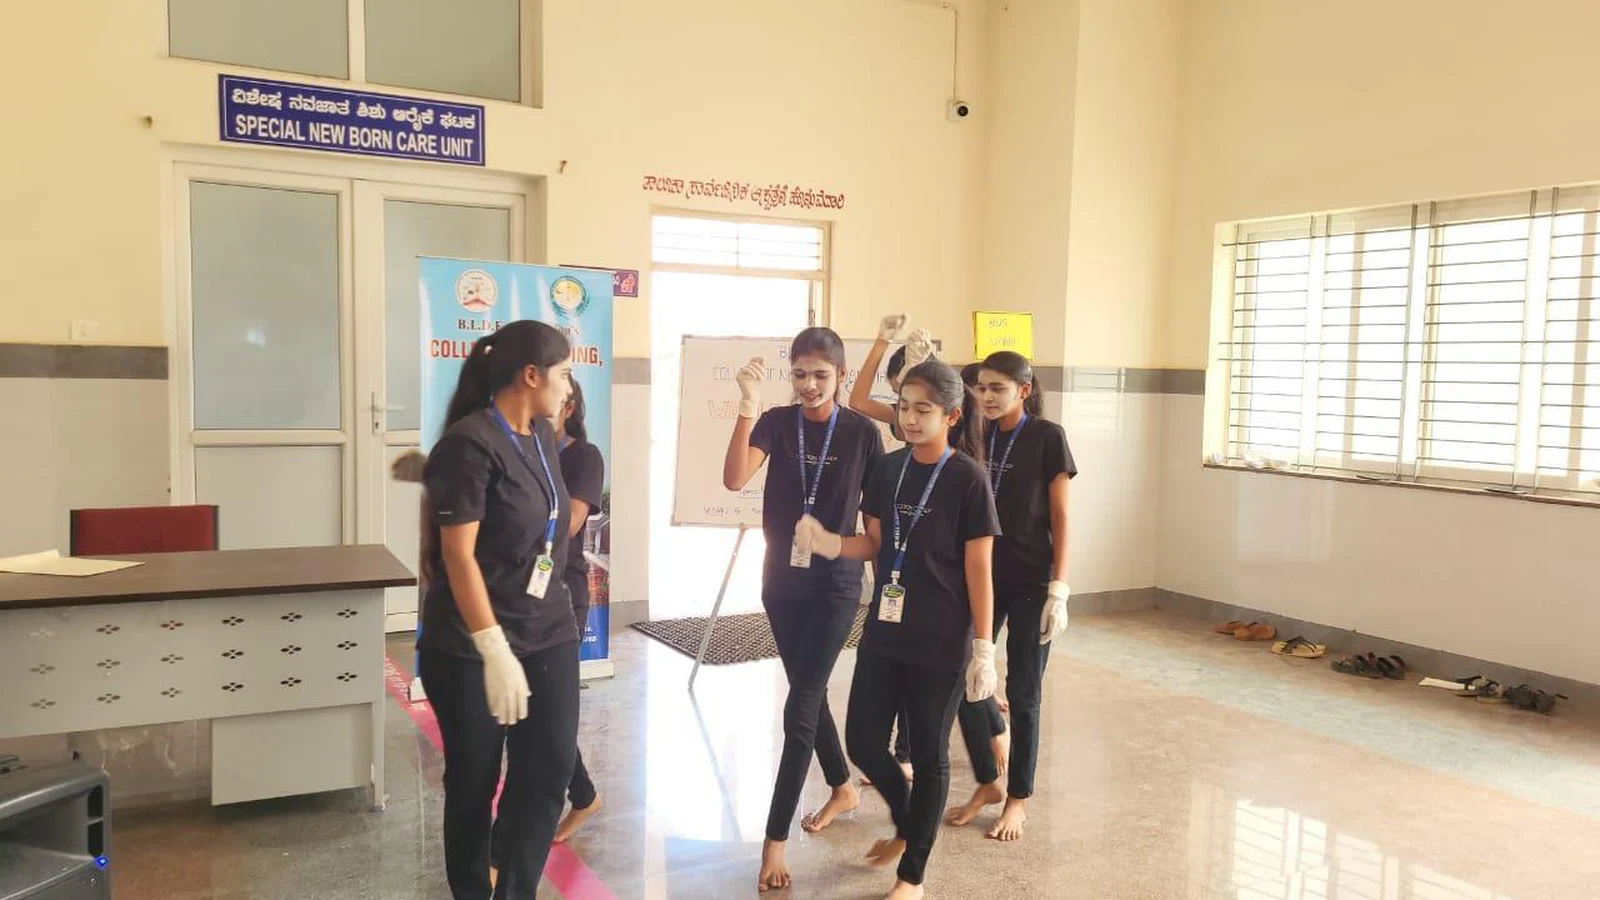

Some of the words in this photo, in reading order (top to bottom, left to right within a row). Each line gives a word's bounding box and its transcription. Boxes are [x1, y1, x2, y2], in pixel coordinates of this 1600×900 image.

[232, 87, 282, 110] ವಿಶೇಷ
[289, 95, 350, 116] ನವಜಾತ
[356, 101, 386, 120] ಶಿಶು
[439, 112, 475, 130] ಘಟಕ
[235, 114, 306, 141] SPECIAL
[309, 122, 345, 145] NEW
[349, 127, 392, 150] BORN
[396, 132, 438, 155] CARE
[440, 137, 474, 158] UNIT
[430, 340, 474, 360] COLL
